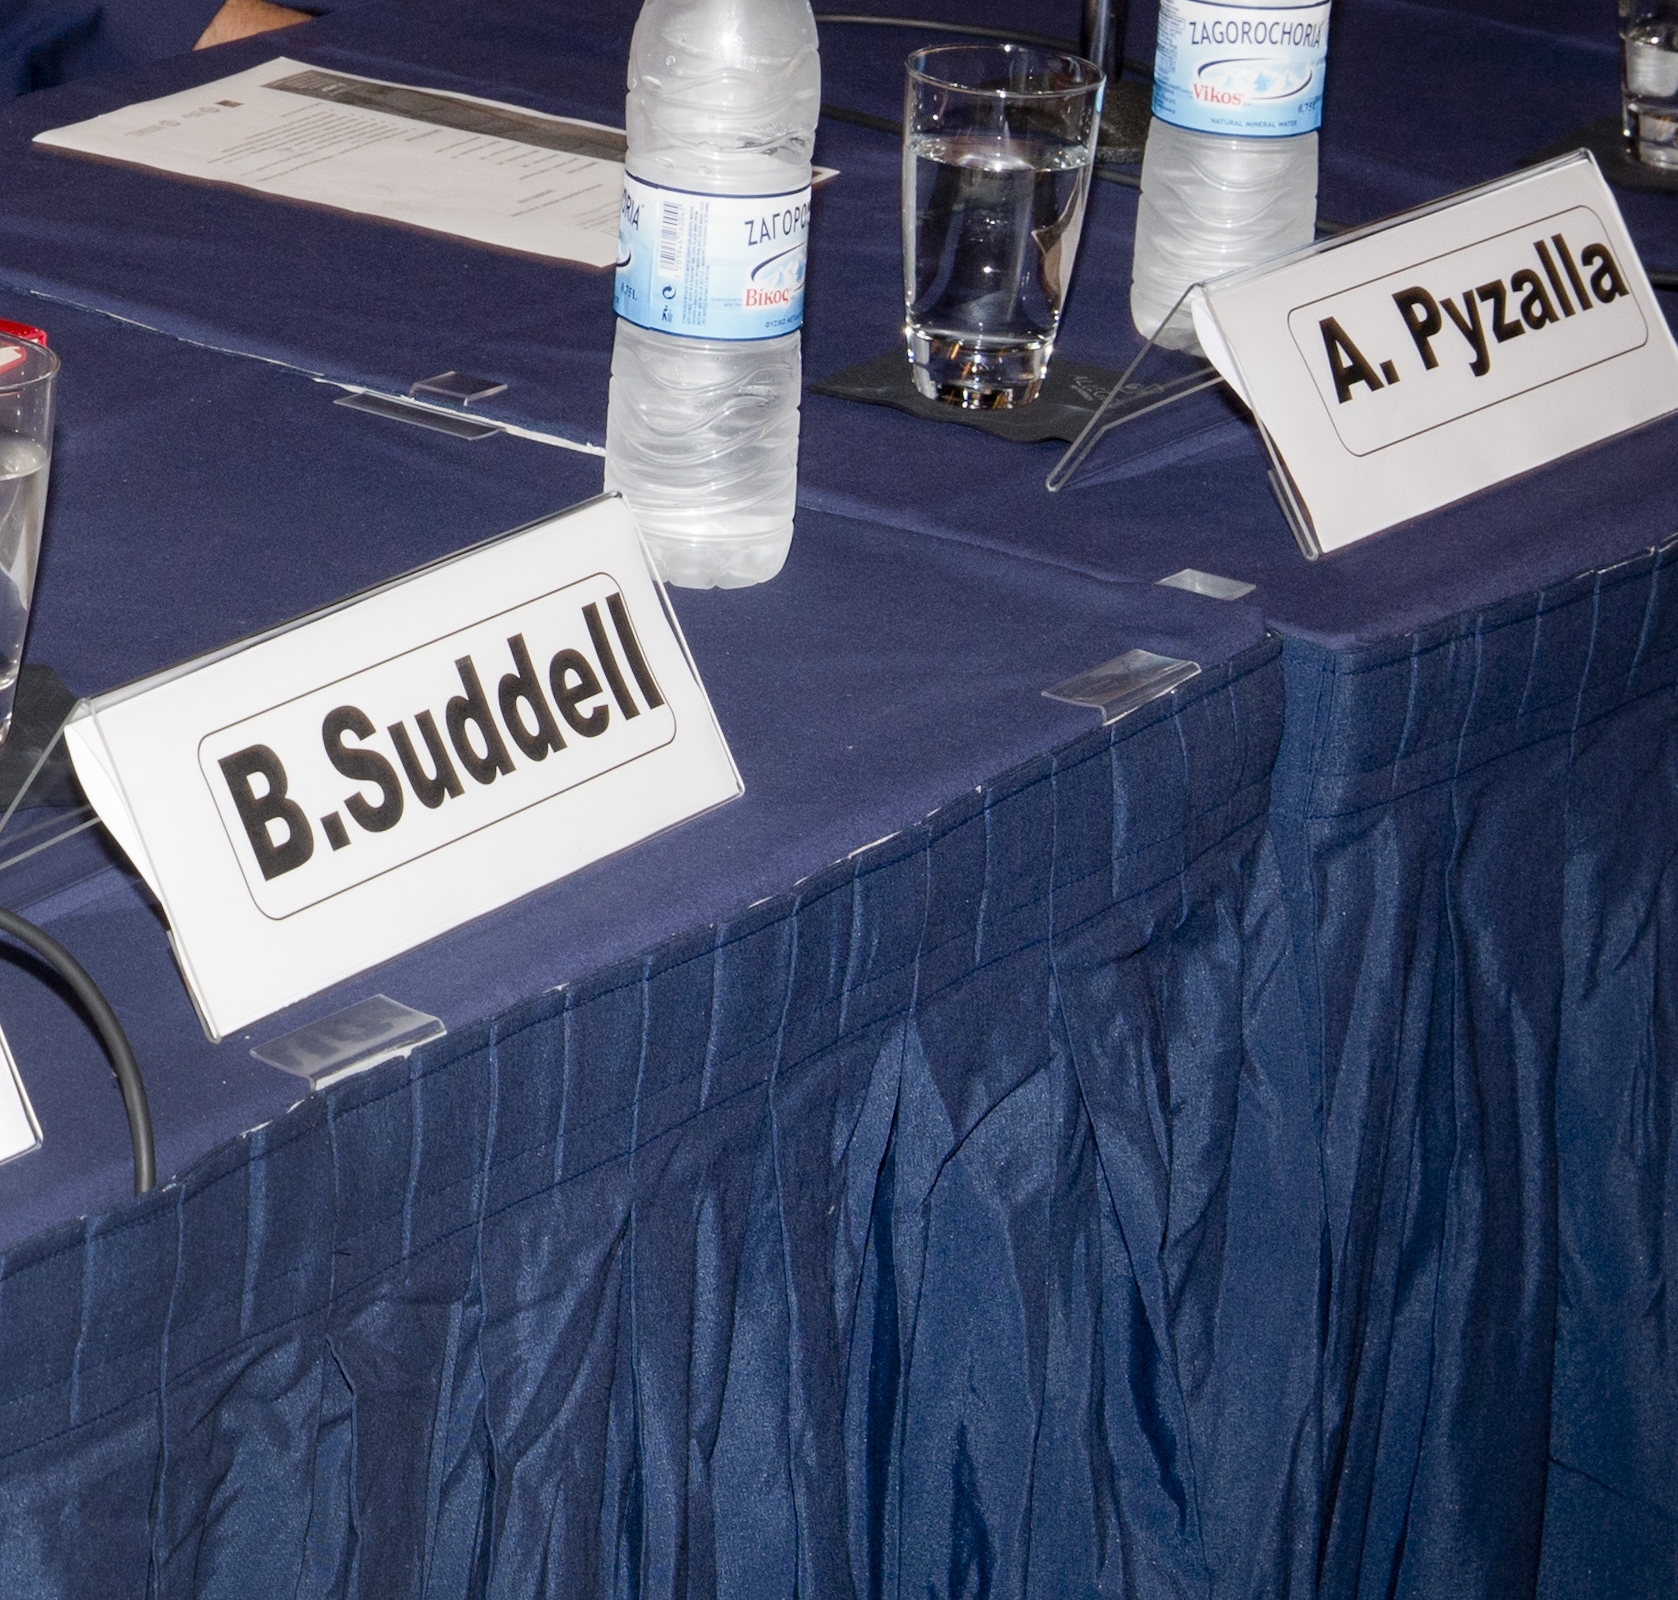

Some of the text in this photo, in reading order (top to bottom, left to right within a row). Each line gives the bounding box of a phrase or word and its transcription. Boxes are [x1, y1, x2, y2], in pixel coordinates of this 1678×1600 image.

[1189, 21, 1322, 48] ZAGOROCHORIA
[1192, 82, 1242, 106] Vikos
[1210, 117, 1297, 128] NATURAL MINERAL WATER
[744, 286, 790, 308] Βίκος
[1318, 233, 1632, 405] A. Pyzalla
[216, 591, 667, 882] B.Suddell
